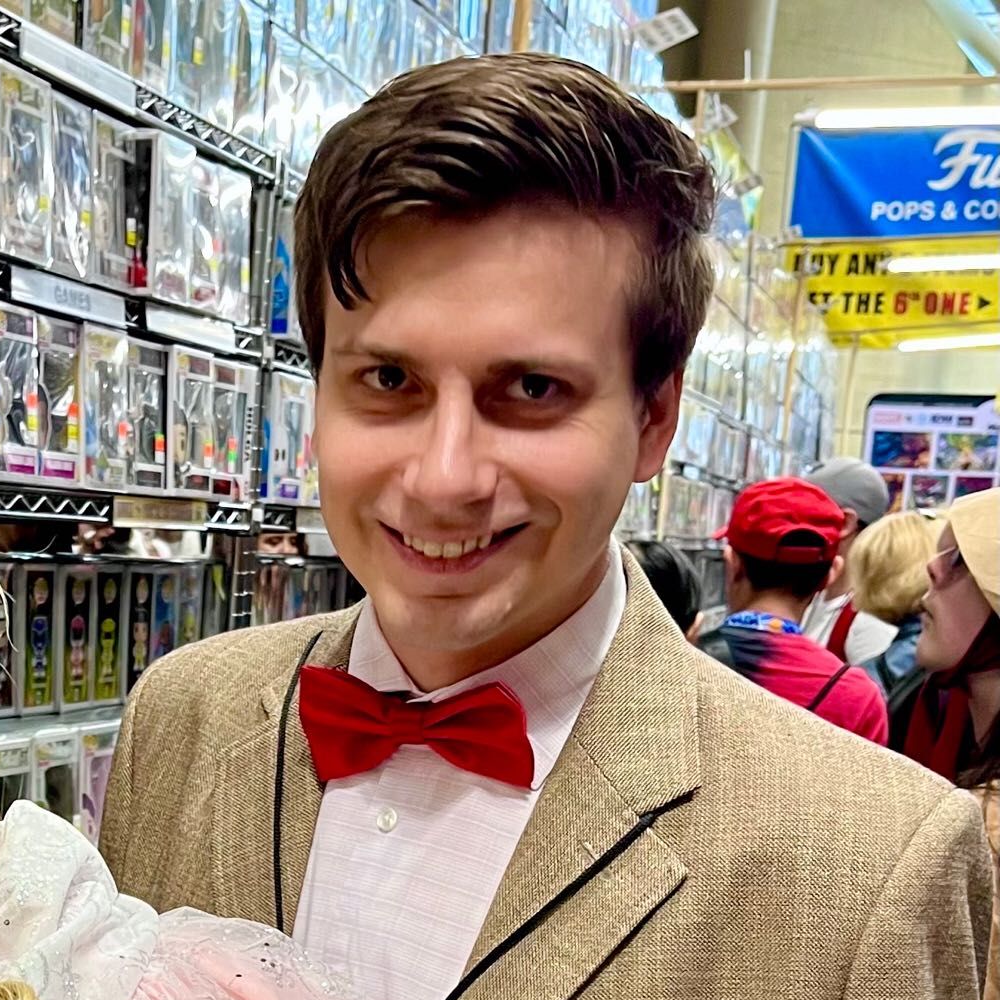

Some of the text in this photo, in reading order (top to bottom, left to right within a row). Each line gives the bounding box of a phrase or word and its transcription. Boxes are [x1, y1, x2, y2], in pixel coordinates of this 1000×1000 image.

[870, 199, 1000, 222] POPS & CO
[842, 291, 884, 315] THE
[924, 291, 971, 315] ONE
